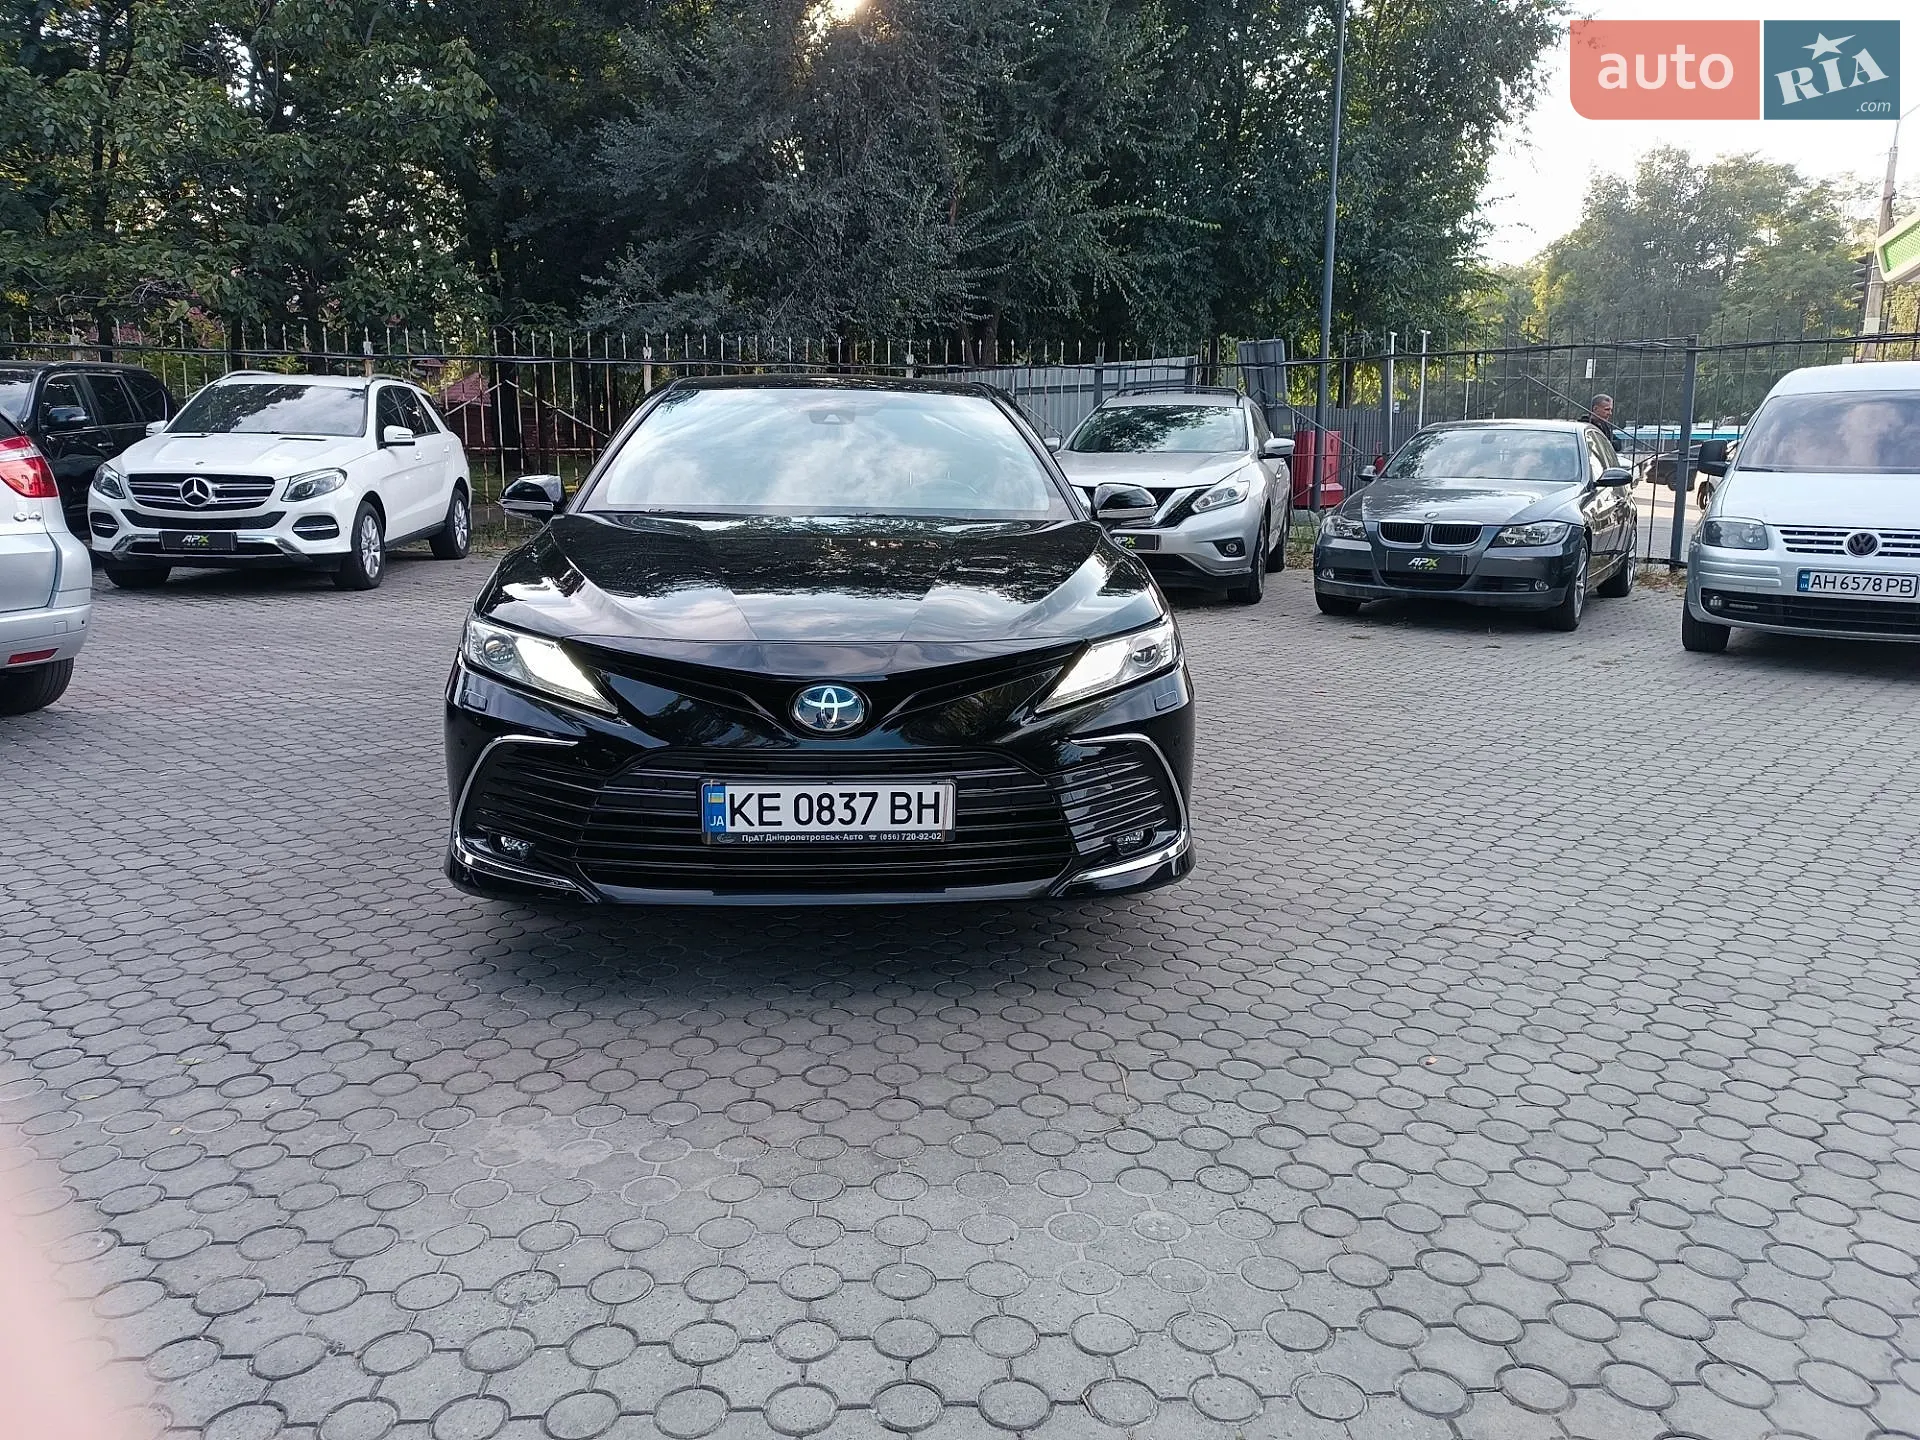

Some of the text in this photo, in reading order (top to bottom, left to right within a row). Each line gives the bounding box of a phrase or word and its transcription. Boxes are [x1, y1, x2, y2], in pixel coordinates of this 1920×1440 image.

[729, 791, 941, 827] KE 0837 BH
